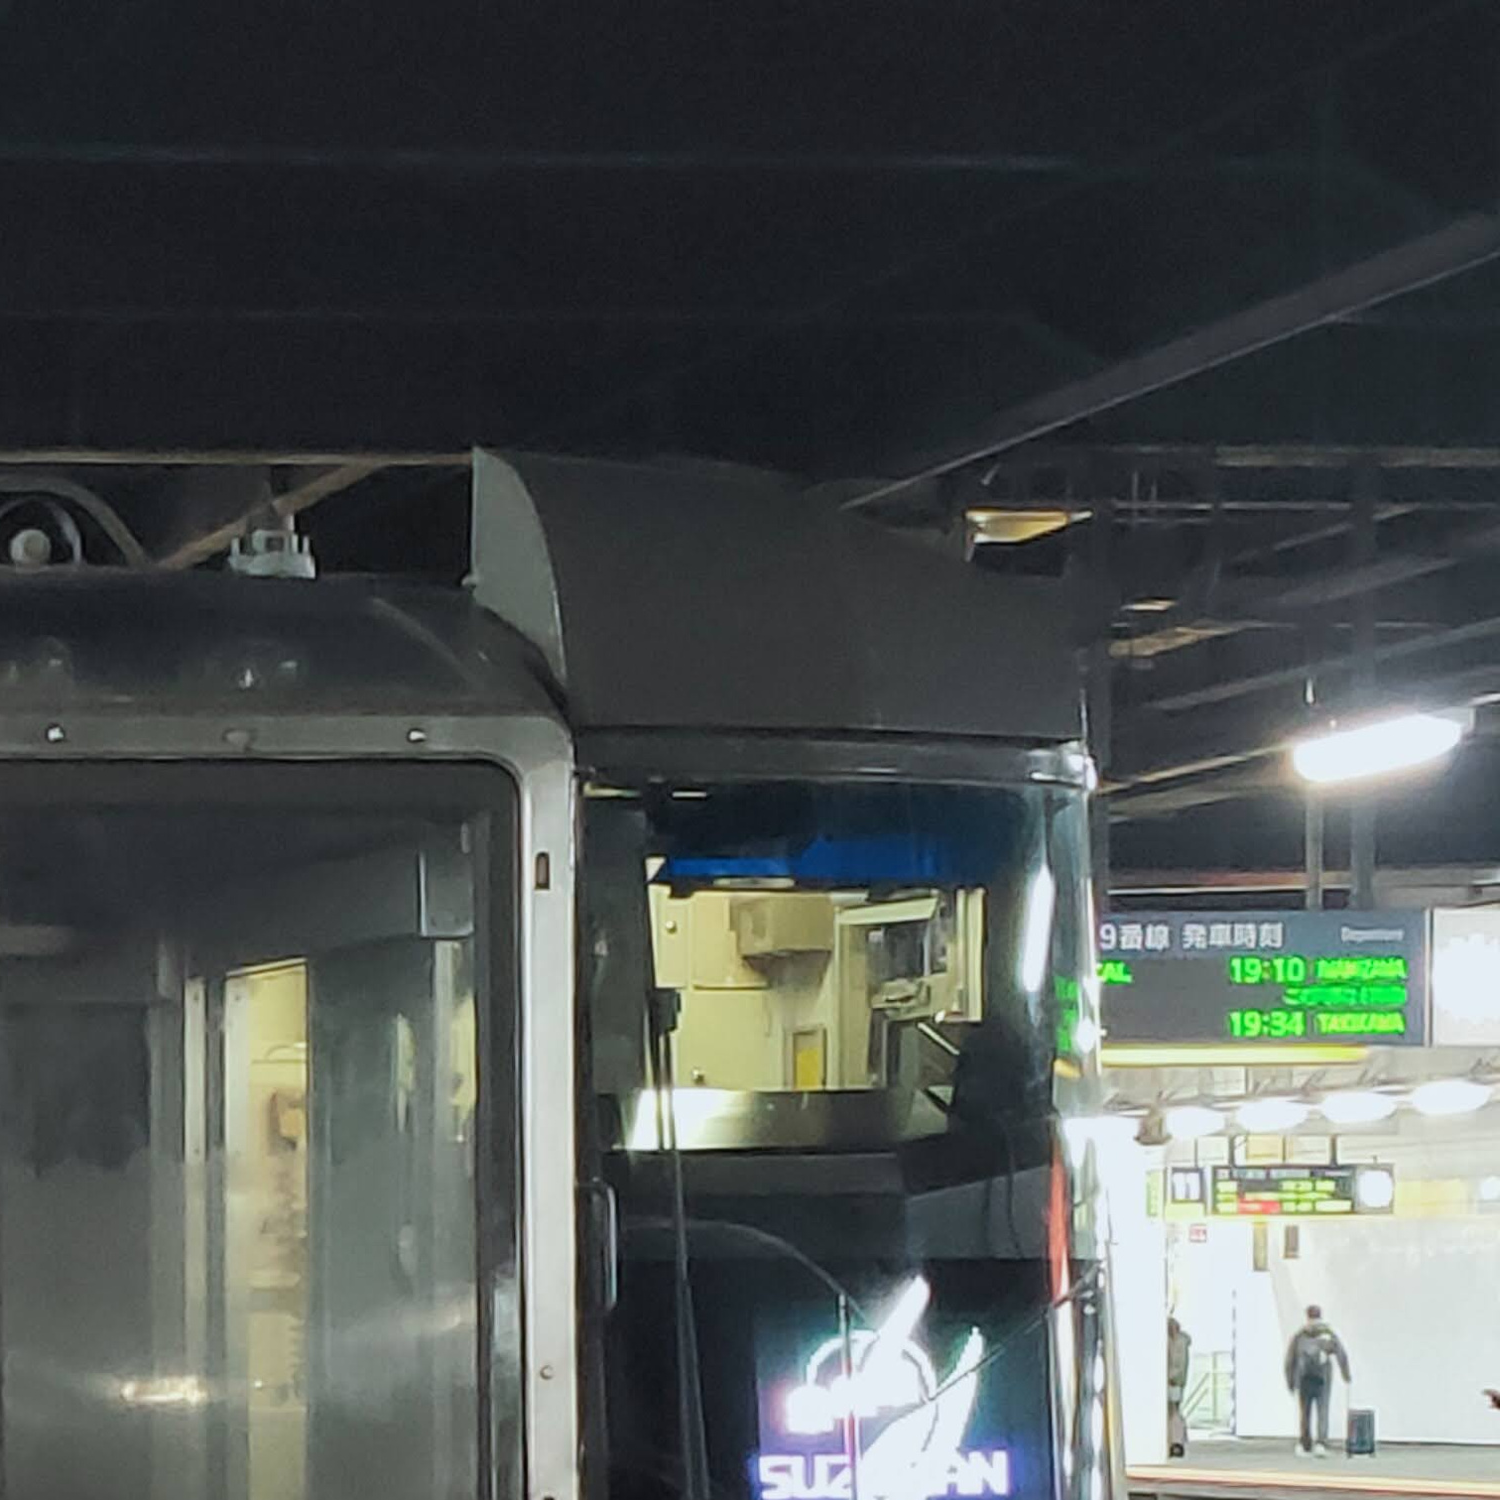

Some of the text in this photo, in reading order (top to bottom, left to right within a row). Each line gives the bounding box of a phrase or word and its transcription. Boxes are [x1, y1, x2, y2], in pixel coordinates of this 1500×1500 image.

[1182, 923, 1284, 950] 発車時刻
[1230, 956, 1306, 984] 19:10
[1230, 1010, 1306, 1038] 19:34
